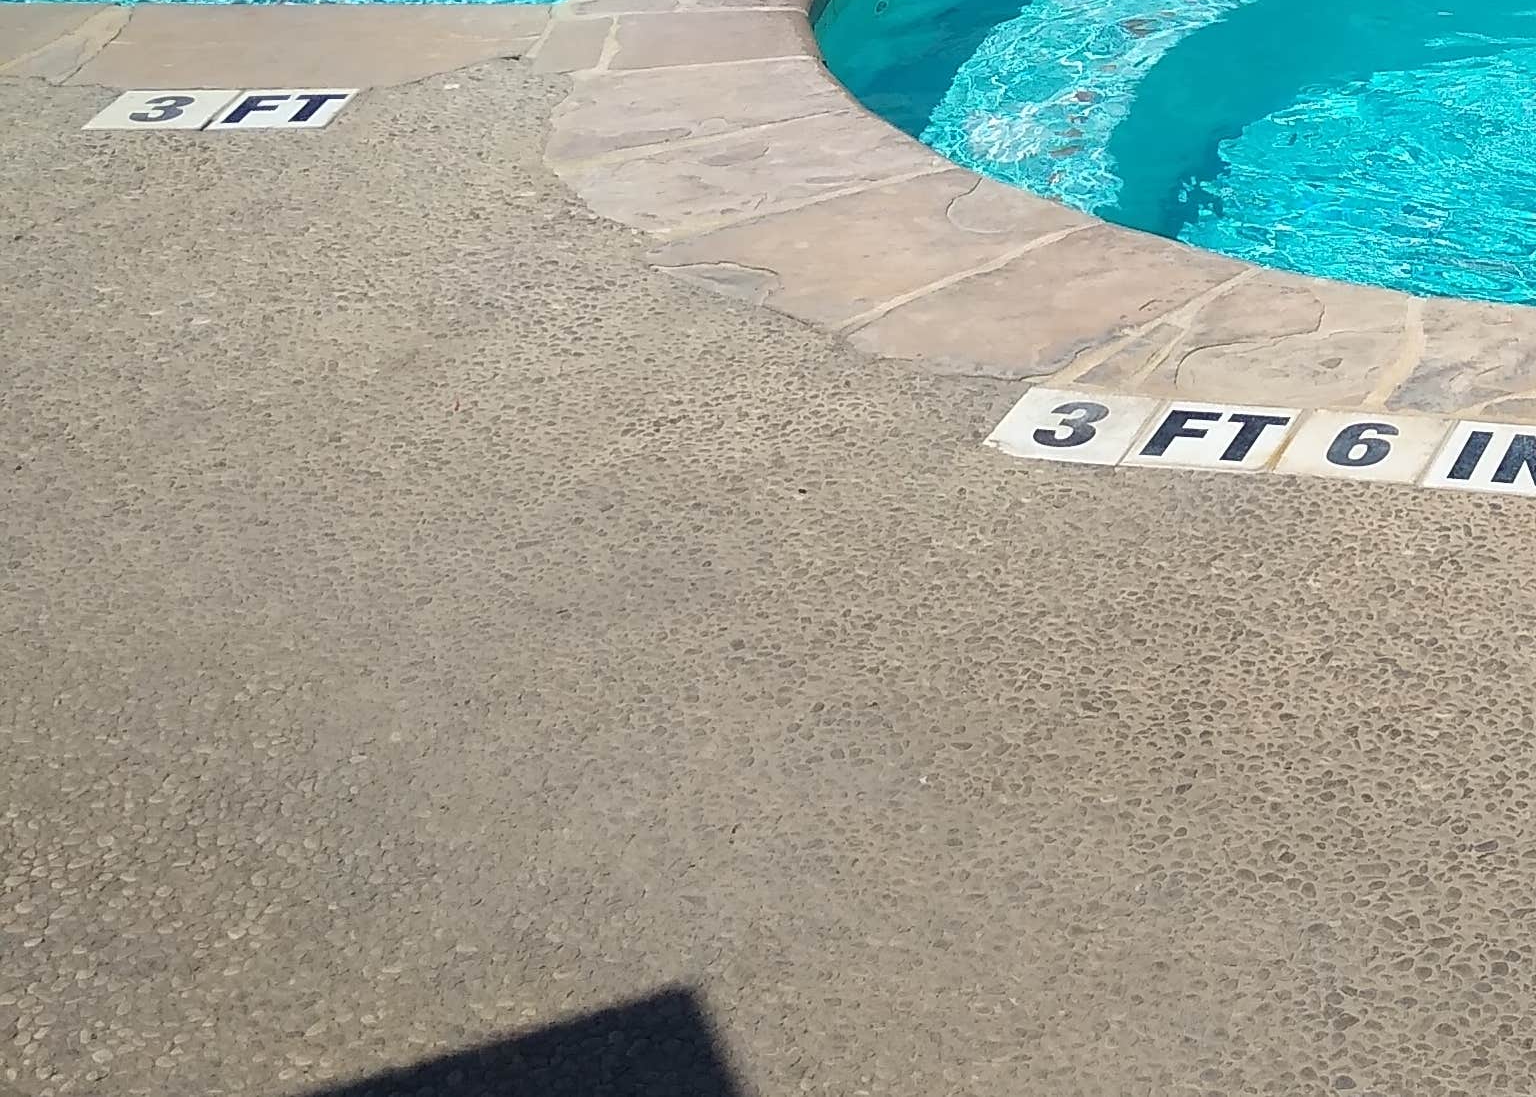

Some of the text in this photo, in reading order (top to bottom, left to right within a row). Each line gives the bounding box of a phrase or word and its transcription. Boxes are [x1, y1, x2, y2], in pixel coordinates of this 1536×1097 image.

[129, 93, 350, 124] 3 FT
[1032, 402, 1110, 448] 3
[1138, 409, 1292, 462] FT
[1325, 422, 1400, 467] 6
